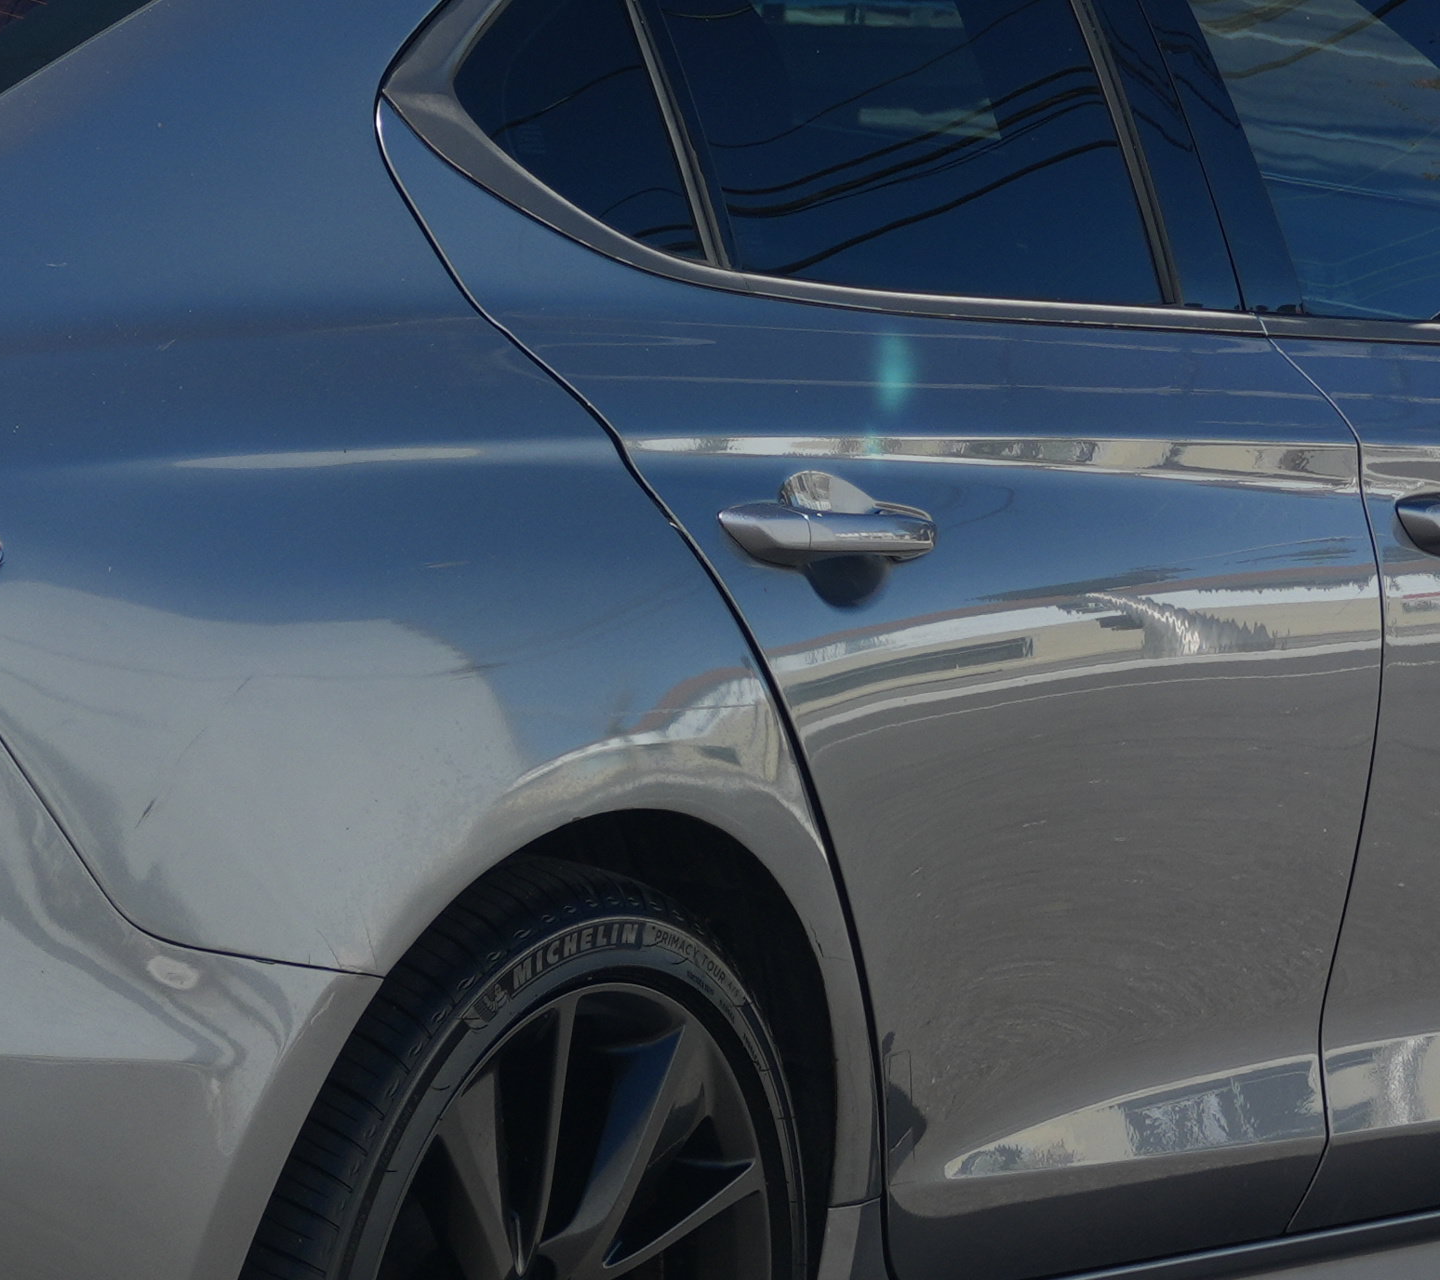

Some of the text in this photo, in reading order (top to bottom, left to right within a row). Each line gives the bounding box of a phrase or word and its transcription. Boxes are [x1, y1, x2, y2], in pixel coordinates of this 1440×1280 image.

[512, 923, 640, 990] MICHELIN
[654, 928, 700, 961] PRIMACY
[701, 953, 727, 984] TOUR
